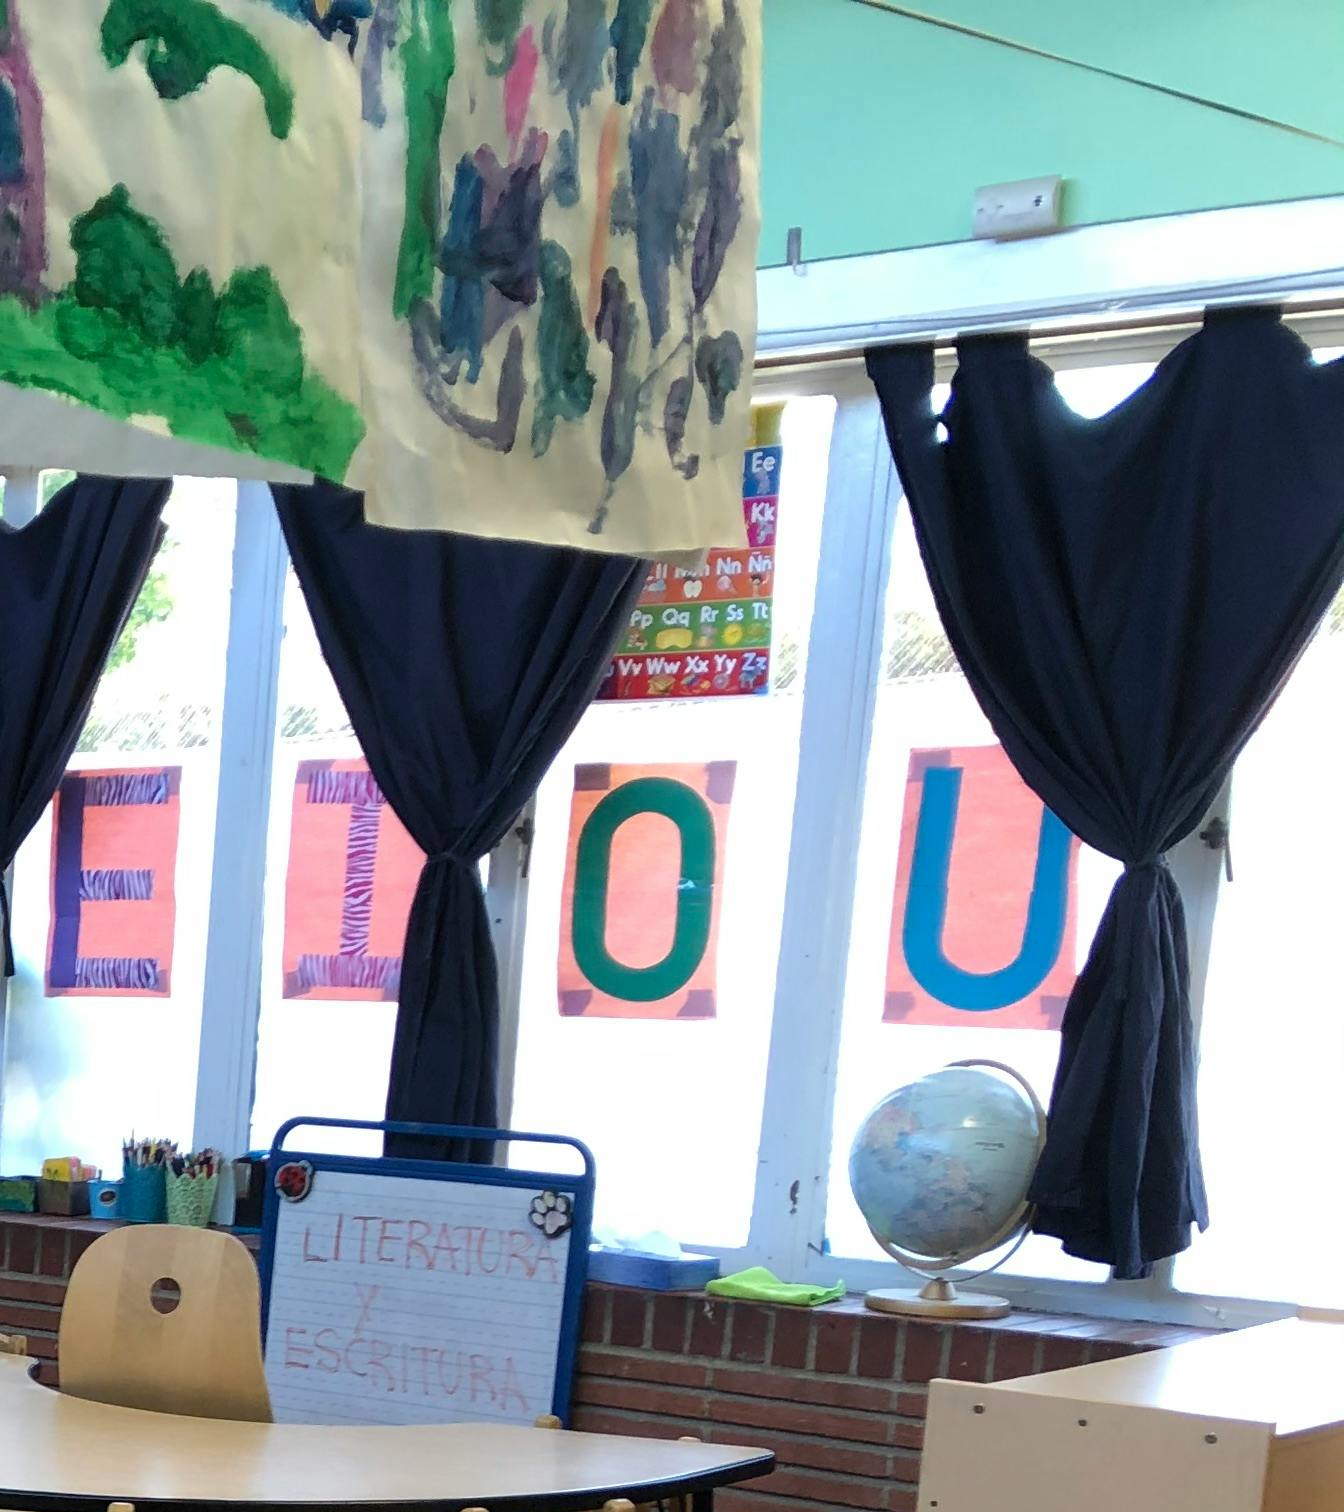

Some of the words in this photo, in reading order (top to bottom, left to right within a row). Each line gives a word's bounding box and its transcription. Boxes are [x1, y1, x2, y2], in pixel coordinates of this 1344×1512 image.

[752, 452, 775, 472] Ee
[751, 503, 775, 523] Kk
[716, 557, 742, 575] Nn
[748, 551, 772, 575] Ññ
[630, 609, 653, 629] Pp
[662, 607, 690, 627] Qq
[700, 605, 719, 623] Rr
[726, 603, 744, 622] Ss
[752, 601, 769, 620] Tt
[618, 657, 642, 676] Vv
[646, 656, 681, 675] Ww
[684, 655, 710, 673] Xx
[714, 653, 737, 675] Yy
[742, 652, 767, 671] Zz
[53, 773, 169, 988] E
[297, 771, 401, 988] I
[572, 776, 716, 1002] O
[903, 766, 1073, 1011] U
[304, 1213, 560, 1283] LITERATURA
[284, 1327, 529, 1413] ESCRITURA
